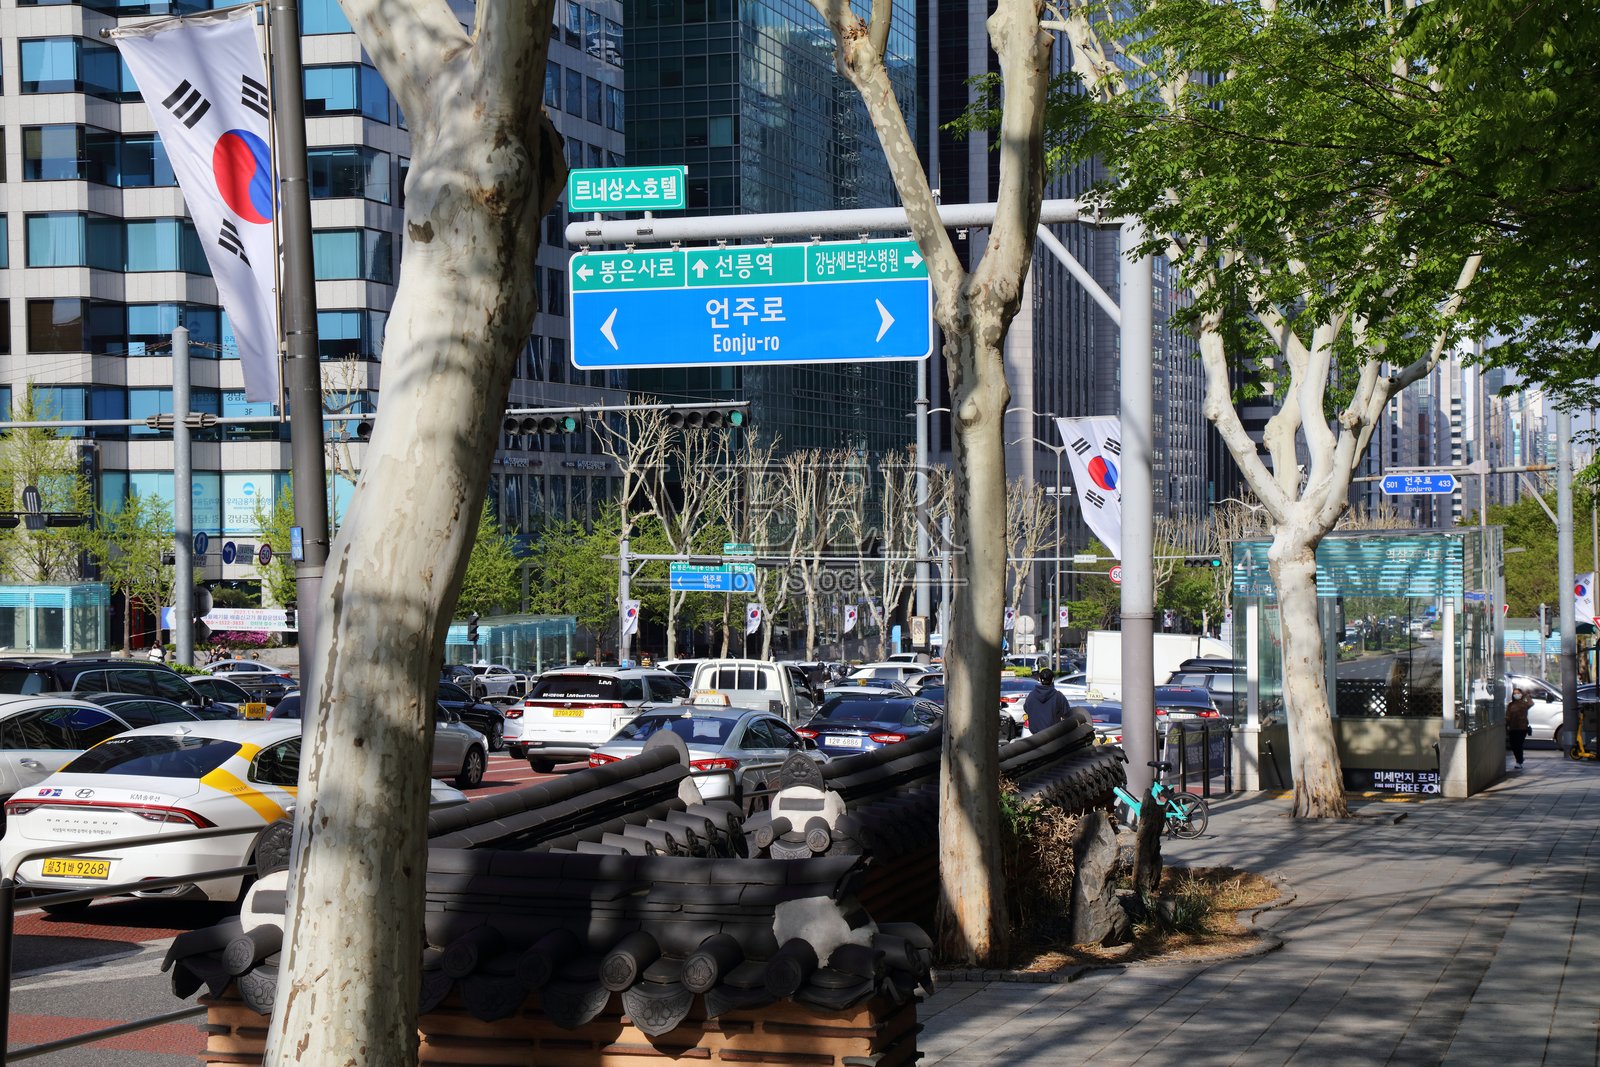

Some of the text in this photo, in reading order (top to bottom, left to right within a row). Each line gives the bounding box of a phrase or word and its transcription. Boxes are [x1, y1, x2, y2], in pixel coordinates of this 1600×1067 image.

[575, 175, 677, 202] 르네상스호텔
[714, 252, 773, 280] 선릉역
[815, 248, 899, 276] 강남세브란스병원
[599, 257, 676, 284] 봉은사로
[705, 296, 787, 329] 언주로
[713, 332, 780, 356] Eonju-ro
[244, 407, 253, 416] 3F
[1386, 481, 1398, 489] 501
[1404, 476, 1433, 486] 언주로
[1438, 480, 1451, 488] 433
[1237, 549, 1252, 576] 4
[1374, 771, 1440, 784] 미세먼지 프리
[1395, 783, 1420, 793] FREE
[129, 793, 161, 803] KM솔루션
[46, 818, 118, 826] GRANDEUR
[77, 862, 105, 875] 9268
